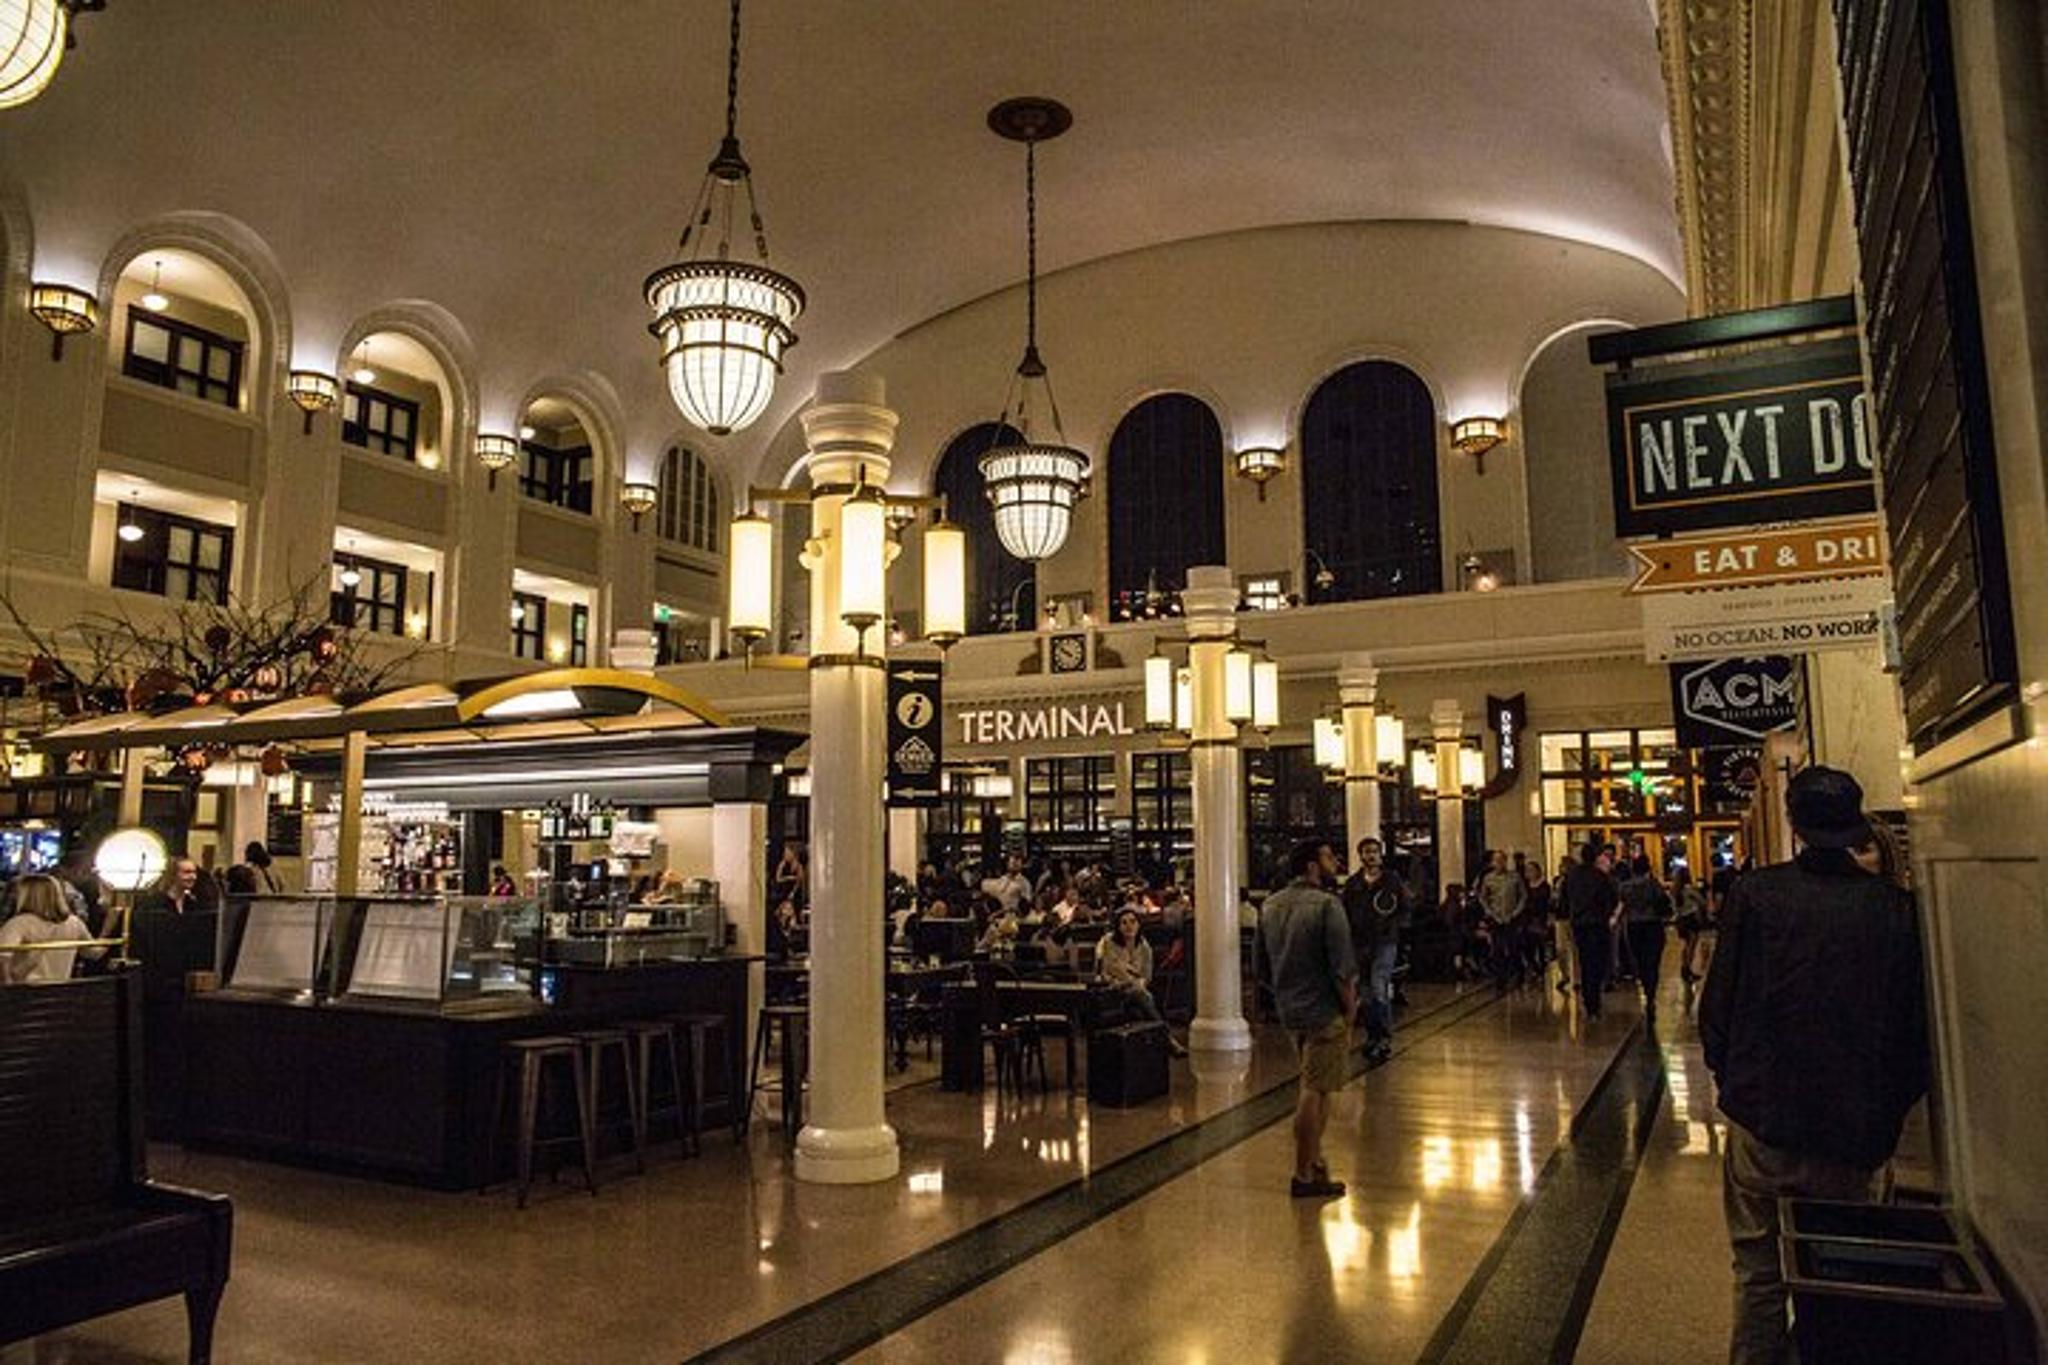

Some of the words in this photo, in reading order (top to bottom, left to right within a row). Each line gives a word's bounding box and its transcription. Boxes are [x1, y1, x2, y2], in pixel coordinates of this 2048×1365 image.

[1640, 405, 1785, 494] NEXT
[1694, 545, 1759, 575] EAT
[1776, 545, 1798, 568] &
[1815, 536, 1877, 564] DRI
[1674, 633, 1703, 649] NO
[1782, 624, 1813, 641] NO
[1692, 673, 1796, 711] ACM
[958, 702, 1134, 744] TERMINAL
[1500, 710, 1515, 769] DRINK
